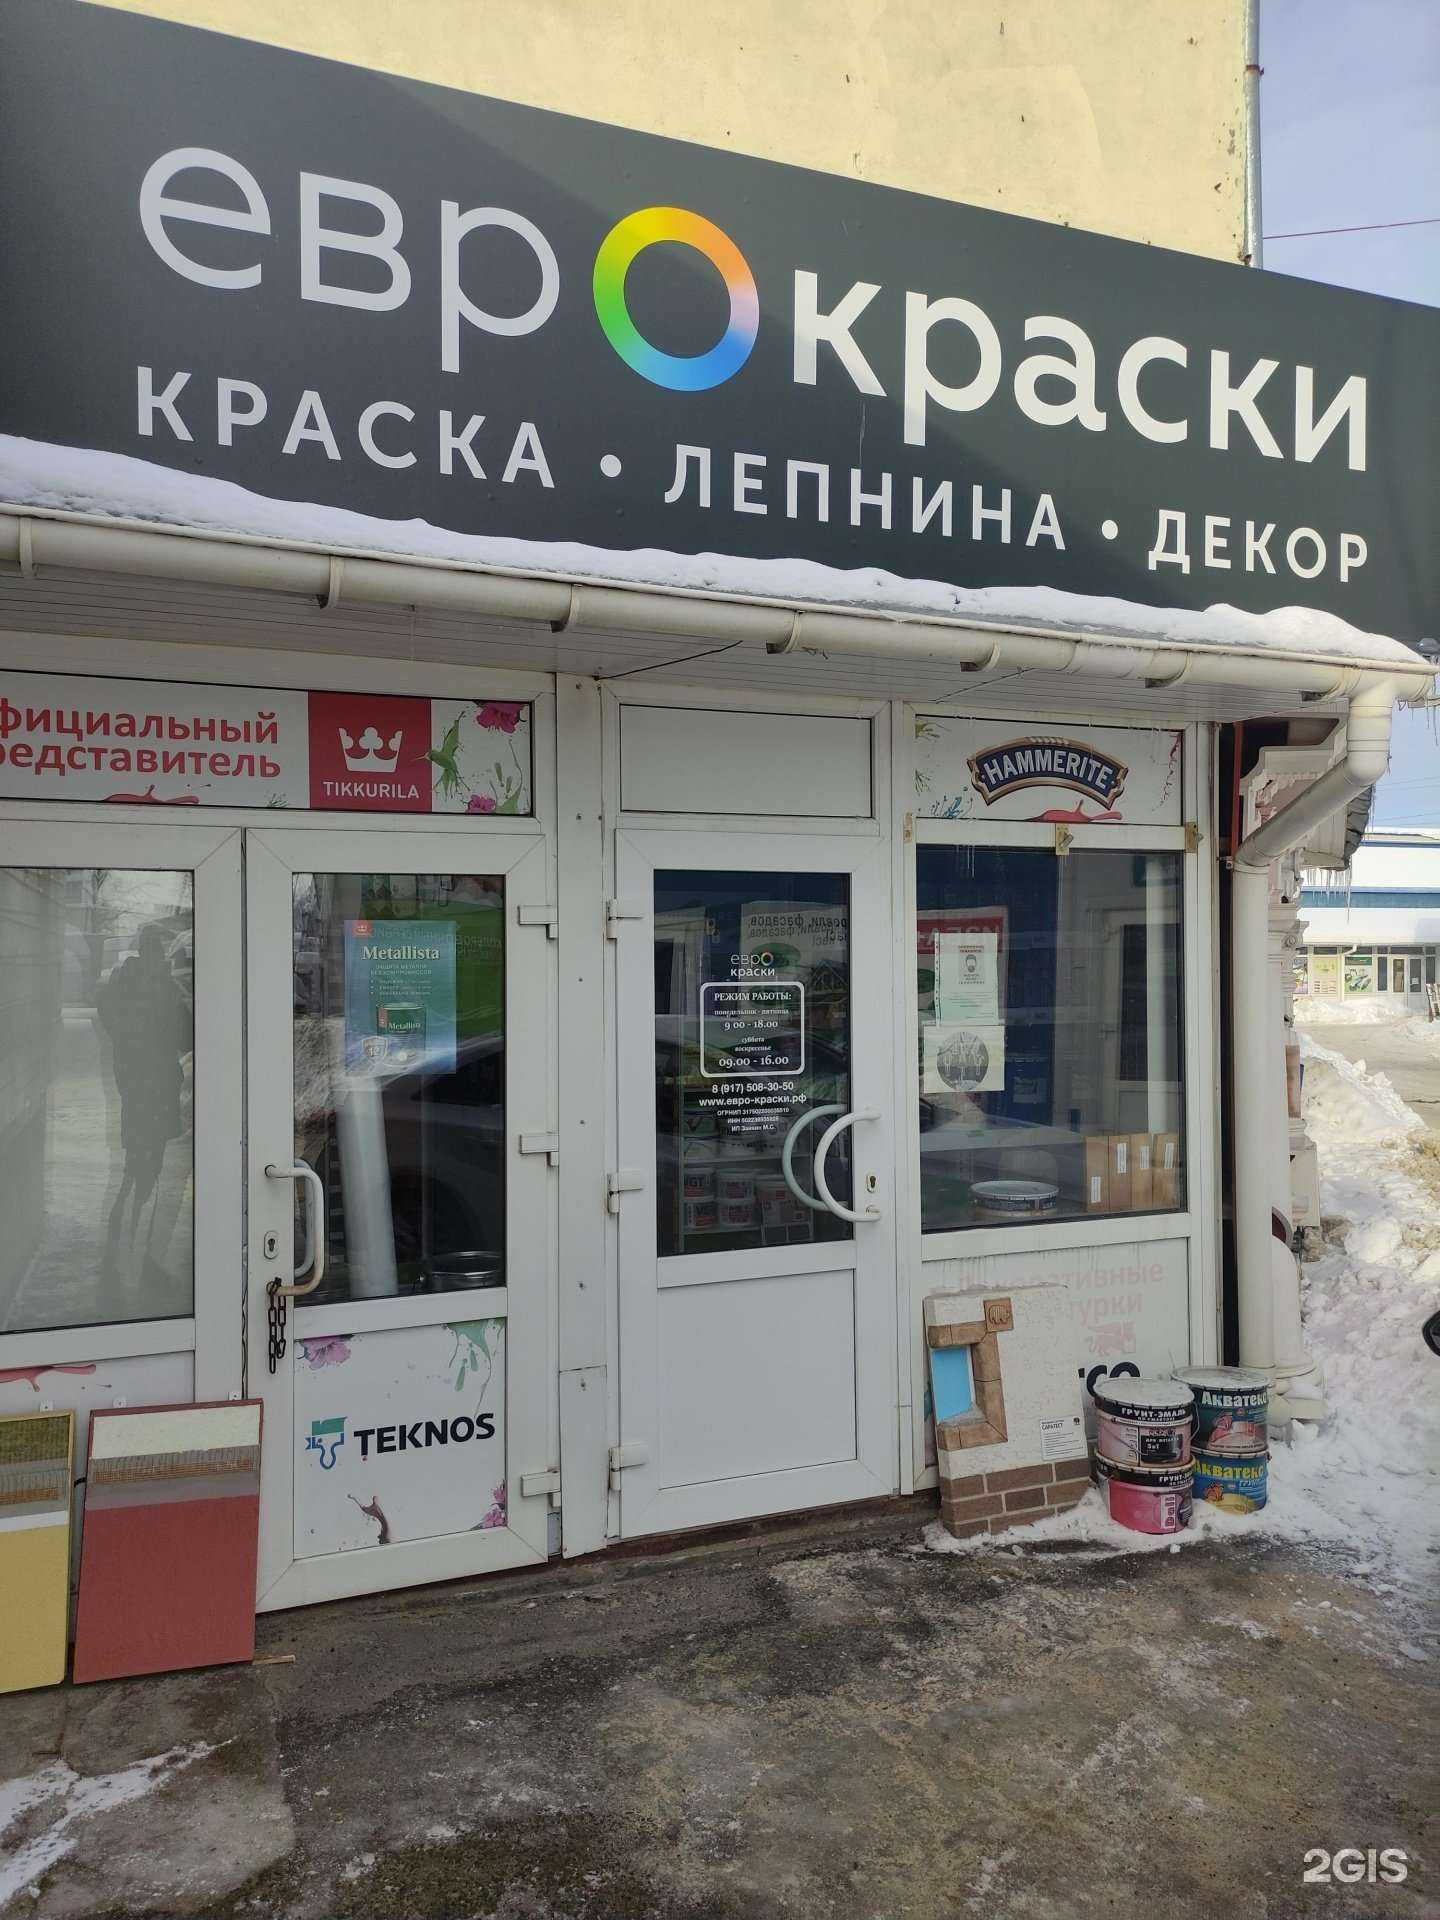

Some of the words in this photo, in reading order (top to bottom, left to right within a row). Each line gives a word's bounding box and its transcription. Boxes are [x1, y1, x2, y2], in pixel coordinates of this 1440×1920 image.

[137, 366, 556, 488] КРАСКА
[664, 444, 1067, 550] ЛЕПНИНА
[1148, 509, 1369, 583] ДЕКОР
[0, 742, 281, 778] едставитель
[983, 749, 1114, 790] HAMMERITE
[322, 781, 420, 799] TIKKURILA
[361, 945, 441, 960] Metallista
[730, 967, 775, 979] краски
[714, 992, 750, 1001] РЕЖИМ
[752, 992, 792, 1000] РАБОТЫ:
[719, 1057, 750, 1068] 09.00
[761, 1055, 789, 1065] 16.00
[712, 1084, 718, 1093] 8
[721, 1083, 744, 1095] (917)
[746, 1081, 794, 1092] 508-30-50
[699, 1093, 807, 1106] www.евро-краски.рф
[353, 1412, 496, 1457] TEKNOS
